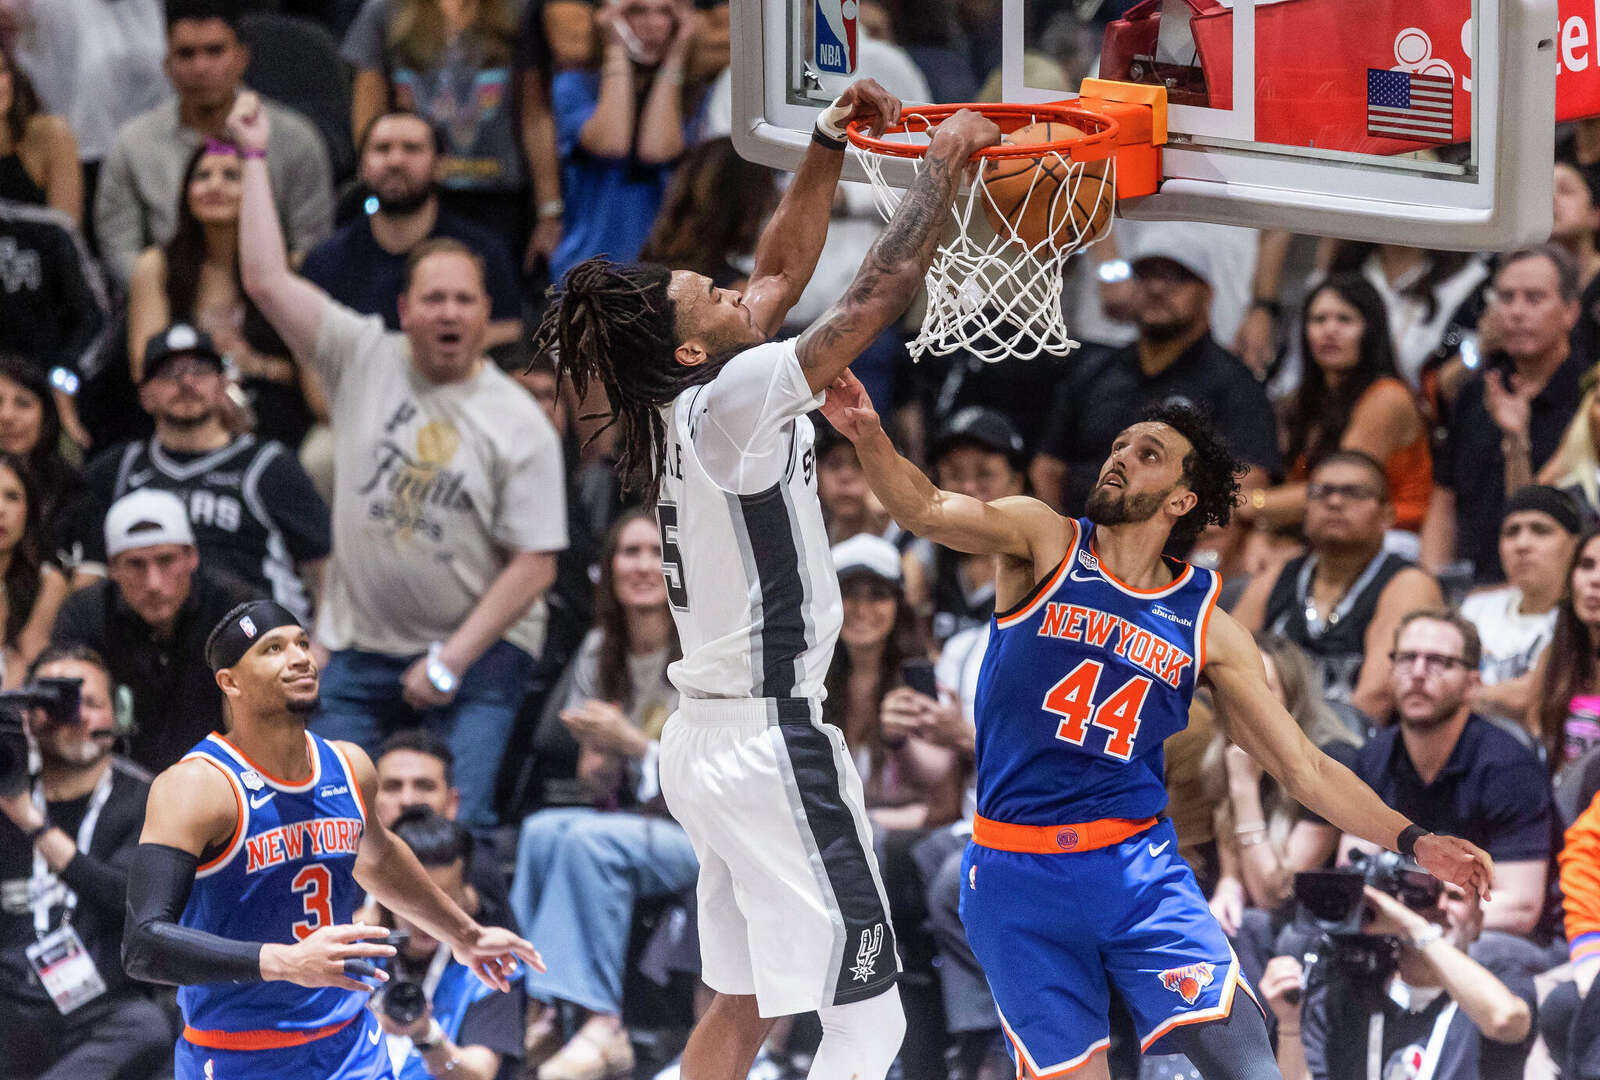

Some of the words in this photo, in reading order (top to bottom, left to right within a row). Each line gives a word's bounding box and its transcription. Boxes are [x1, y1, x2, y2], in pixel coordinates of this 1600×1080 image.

[820, 43, 841, 66] NBA
[655, 500, 691, 613] 5
[1037, 601, 1118, 648] NEW
[1113, 617, 1194, 690] YORK
[1151, 608, 1168, 618] abu
[1168, 613, 1192, 627] dhabi
[1041, 658, 1154, 761] 44
[245, 821, 305, 874] NEW
[304, 817, 363, 856] YORK
[291, 863, 335, 943] 3
